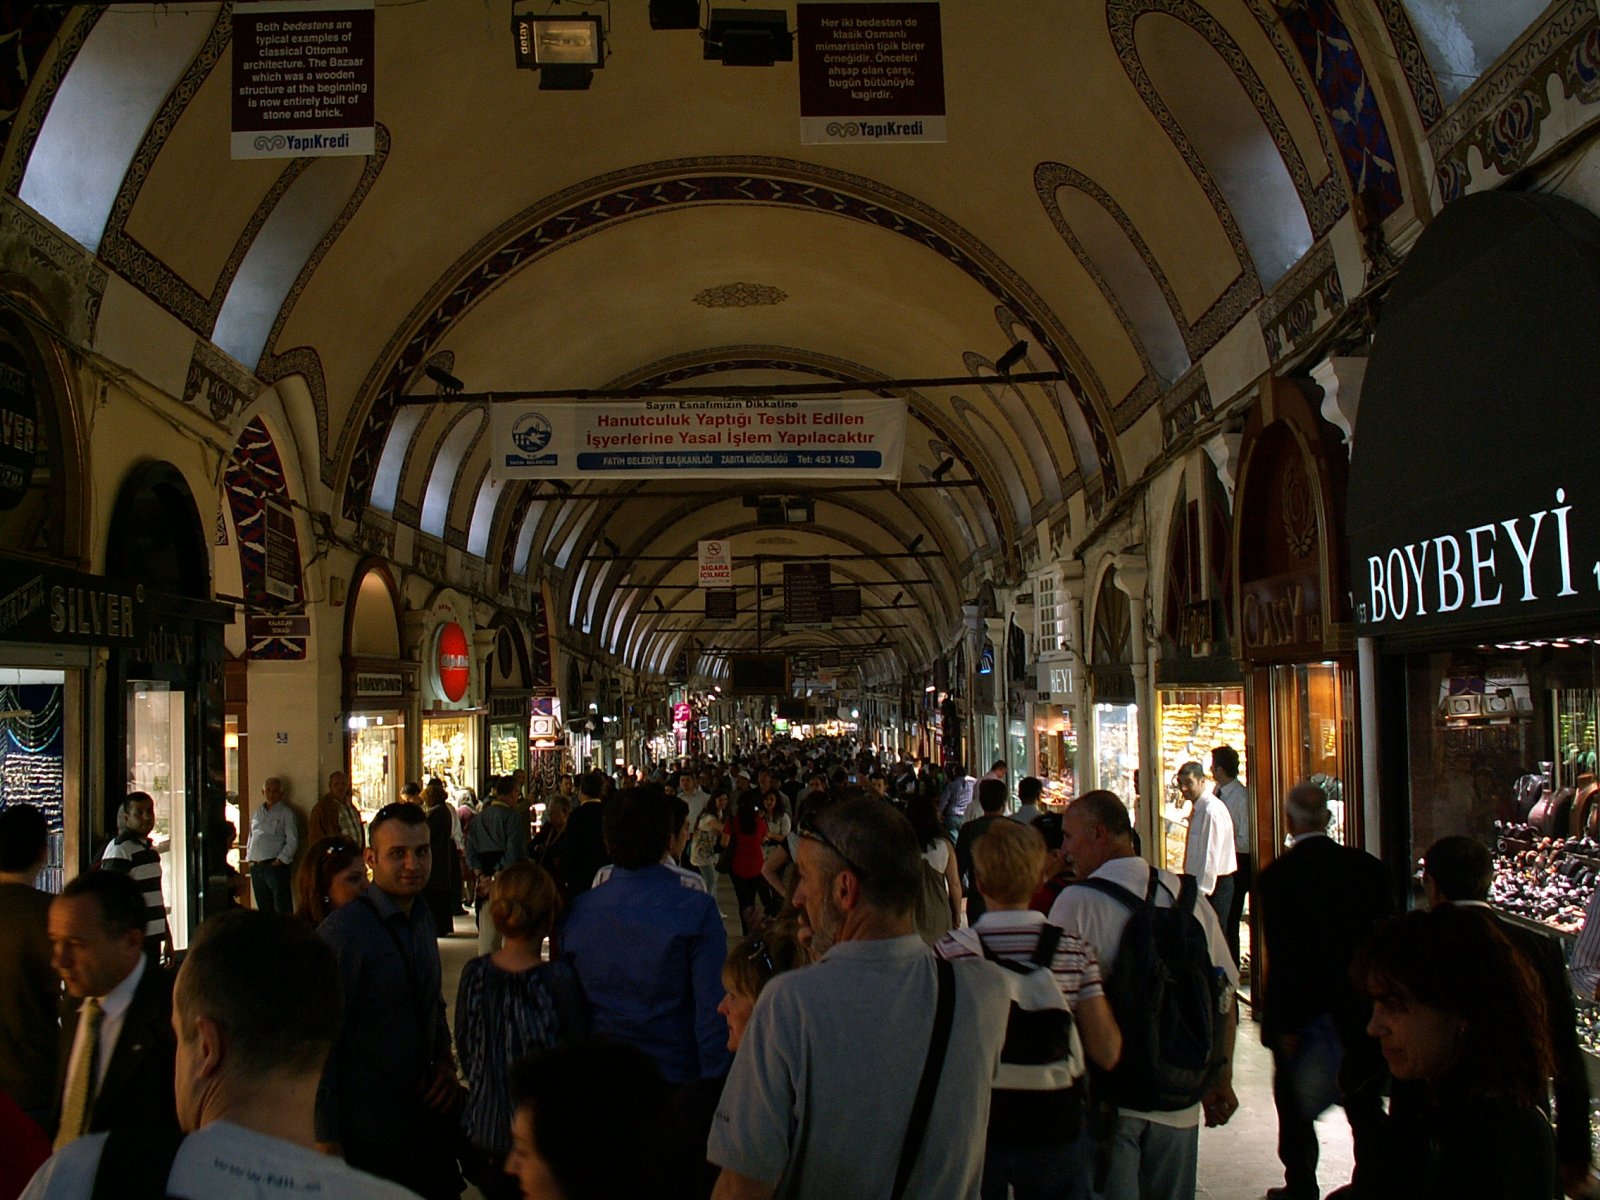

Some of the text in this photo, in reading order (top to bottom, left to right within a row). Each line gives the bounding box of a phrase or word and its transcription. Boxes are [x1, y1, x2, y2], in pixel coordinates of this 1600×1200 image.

[256, 22, 280, 32] Both
[336, 21, 352, 29] are
[821, 17, 918, 28] Her iki bedesten de
[256, 32, 352, 46] typical examples of
[520, 22, 529, 54] detay
[833, 30, 907, 39] klasik Osmanlı
[259, 46, 348, 57] classical Ottoman
[816, 41, 926, 52] mimarisinin tipik birer
[875, 52, 918, 62] Önceleri
[243, 57, 364, 70] architecture. The Bazaar
[252, 72, 282, 82] which
[284, 74, 304, 82] was
[315, 70, 355, 80] wooden
[828, 66, 860, 76] ahşap
[862, 66, 884, 74] olan
[239, 82, 368, 96] structure at the beginning
[828, 77, 915, 89] bugün bütünüyle
[248, 94, 359, 108] is now entirely built of
[262, 108, 344, 120] stone and brick.
[860, 121, 923, 138] YapıKredi
[286, 134, 349, 151] YapıKredi
[646, 400, 798, 412] Sayın Esnafımızın Dikkatine
[597, 412, 864, 428] Hanutculuk Yaptığı Tesbit Edilen
[586, 428, 875, 448] İşyerlerine Yasal İşlem Yapılacaktır
[720, 455, 746, 464] ZABITA
[797, 455, 814, 464] Tel:
[815, 456, 832, 464] 453
[834, 455, 856, 464] 1453
[1368, 487, 1580, 623] BOYBEYİ
[50, 585, 135, 638] SILVER
[1243, 586, 1302, 648] CLASSY
